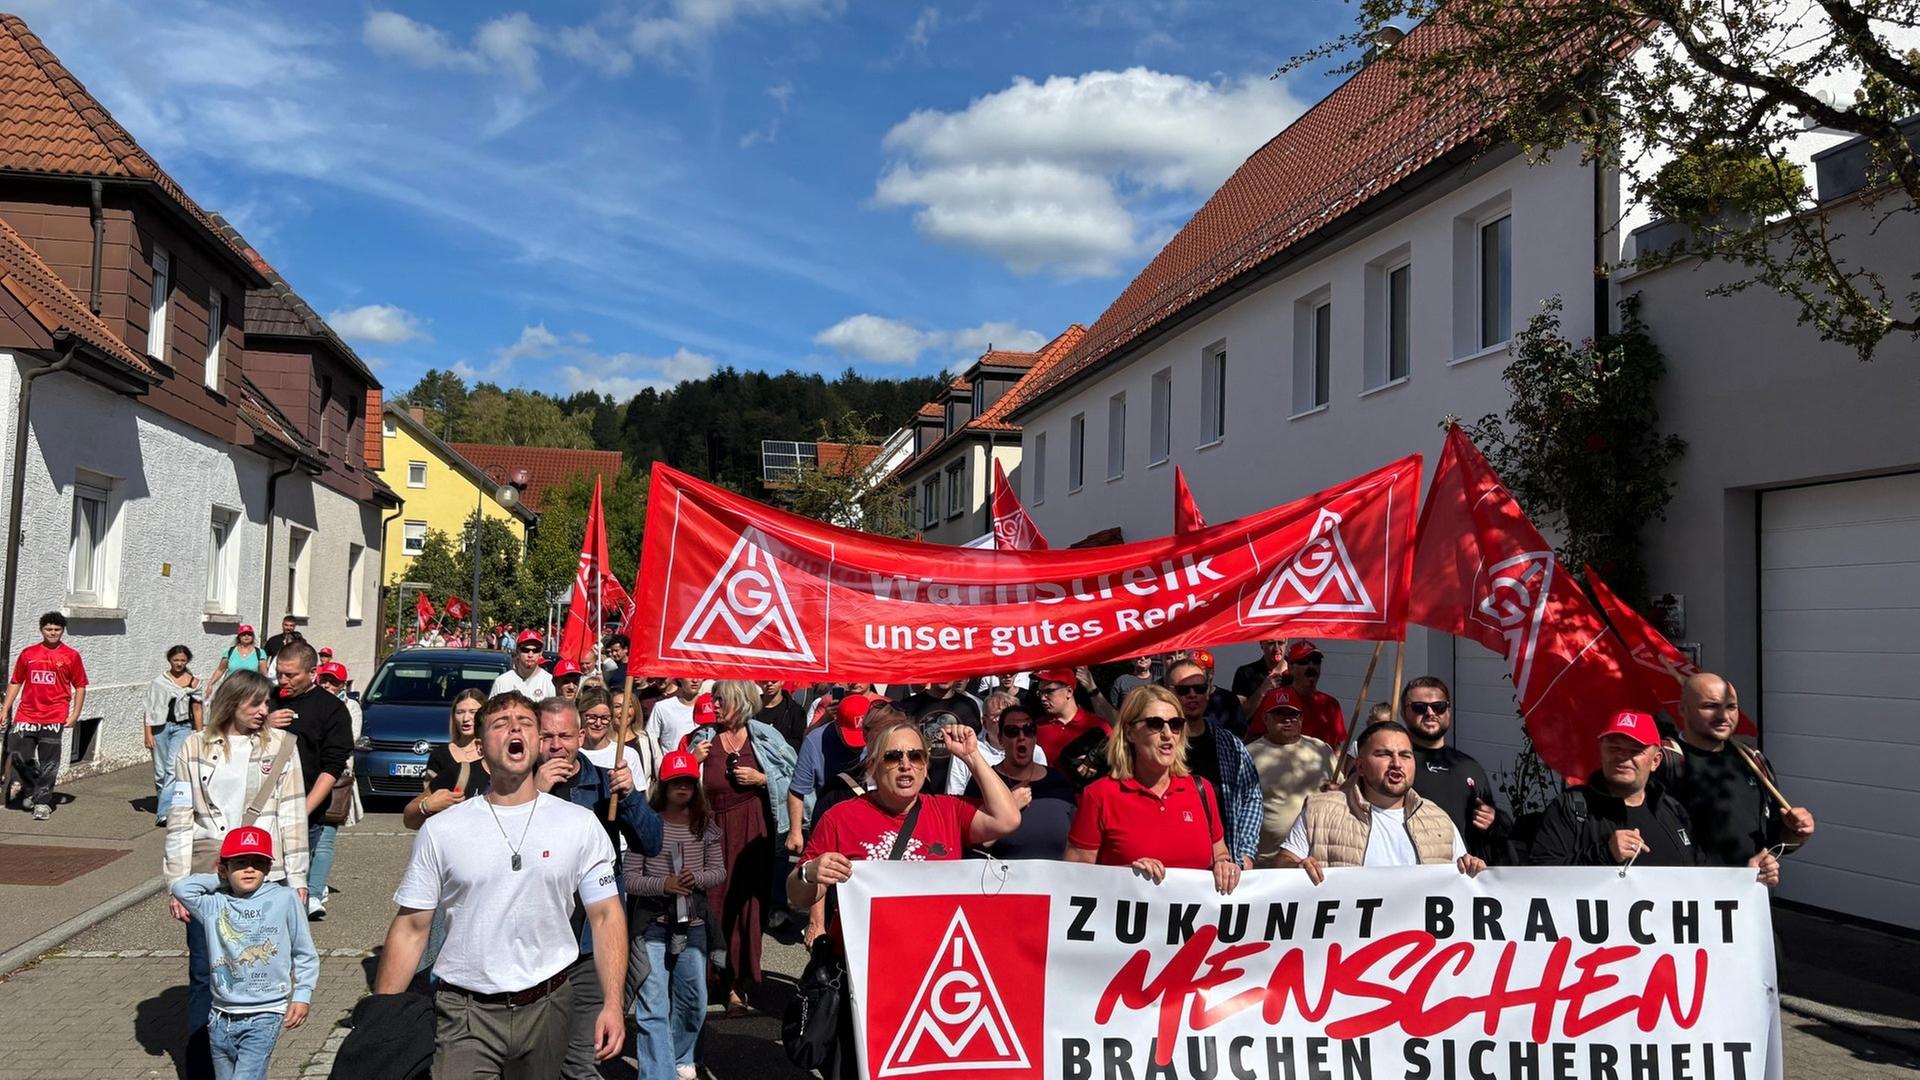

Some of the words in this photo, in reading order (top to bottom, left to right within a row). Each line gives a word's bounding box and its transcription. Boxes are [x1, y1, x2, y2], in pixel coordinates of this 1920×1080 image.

[864, 624, 979, 651] unser
[990, 618, 1105, 657] gutes
[1115, 592, 1221, 633] Rech
[32, 672, 55, 685] AIG
[1066, 896, 1384, 945] ZUKUNFT
[1425, 897, 1740, 945] BRAUCHT
[1095, 925, 1708, 1067] MENSCHEN
[1062, 1036, 1373, 1080] BRAUCHEN
[1404, 1037, 1752, 1080] SICHERHEIT
